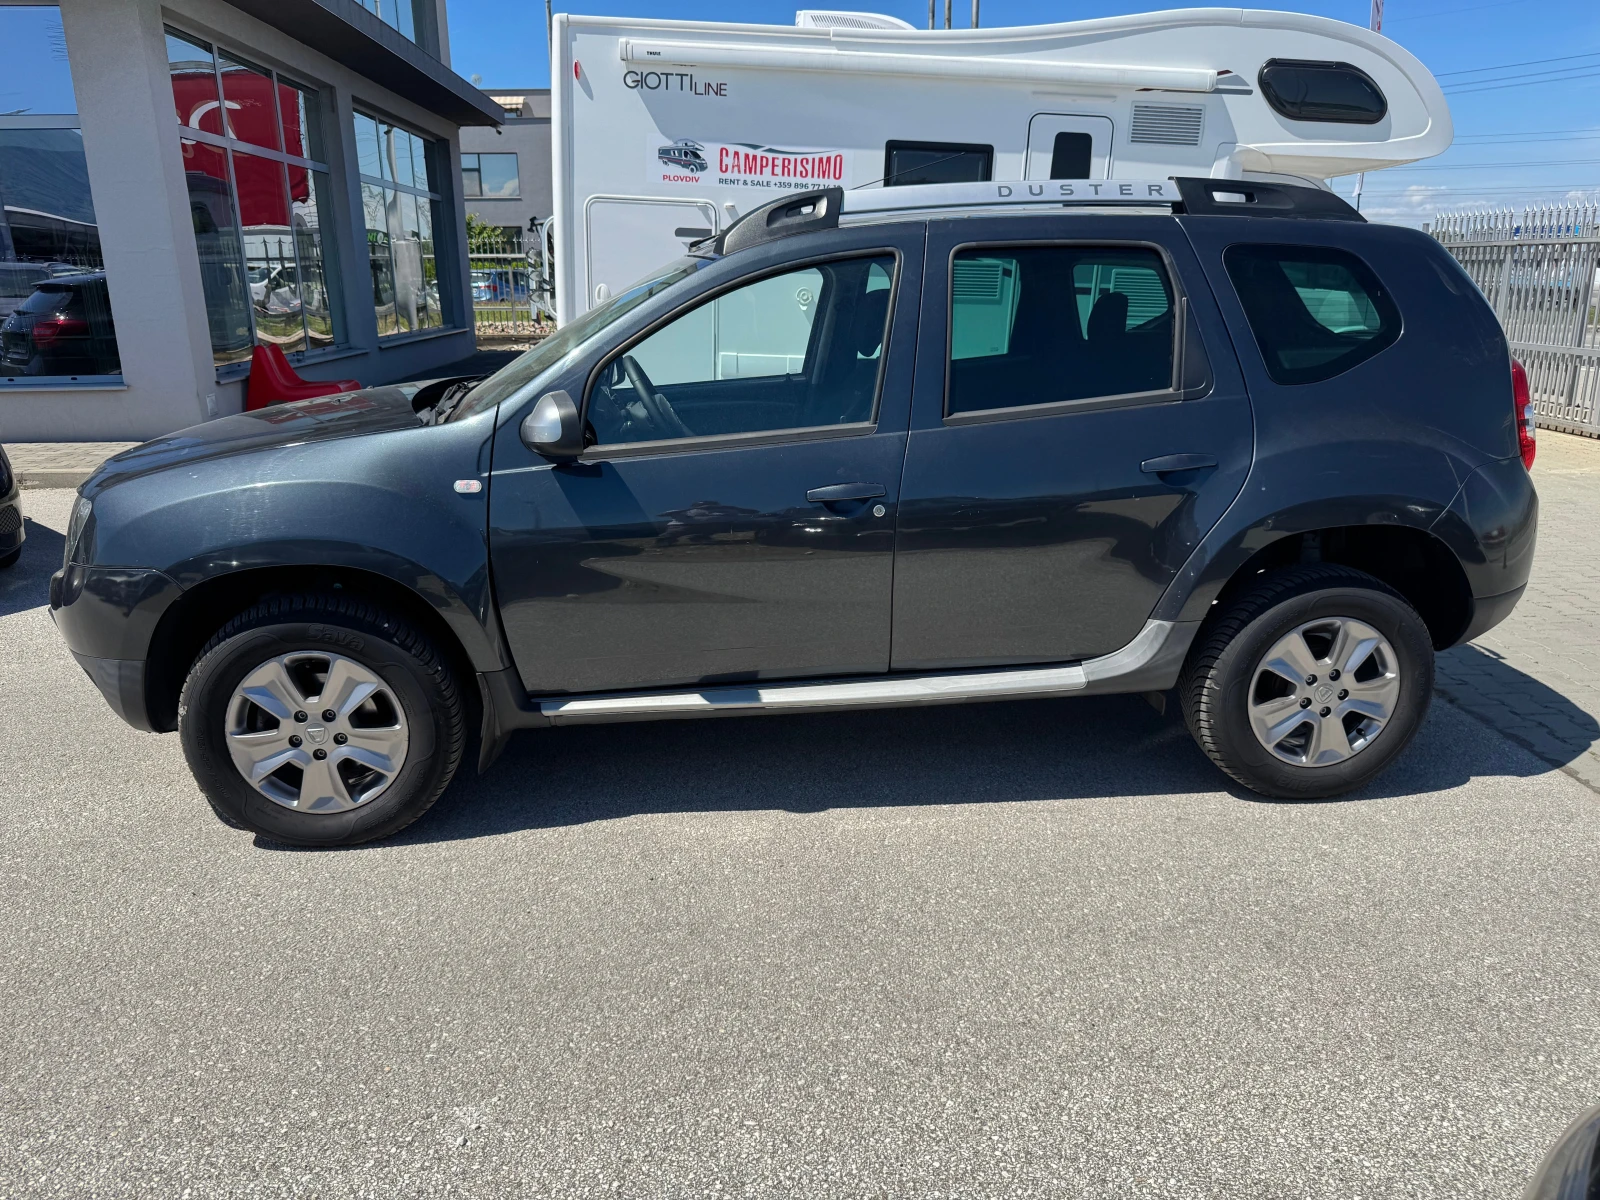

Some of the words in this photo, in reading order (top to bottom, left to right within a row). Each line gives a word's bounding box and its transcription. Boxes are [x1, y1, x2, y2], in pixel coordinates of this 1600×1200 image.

[719, 147, 844, 180] CAMPERISIMO
[662, 174, 700, 183] PLOVDIV
[718, 178, 741, 186] RENT
[742, 179, 749, 187] &
[750, 180, 772, 188] SALE
[773, 181, 792, 189] +359
[794, 182, 810, 190] 896
[997, 184, 1164, 198] DUSTER
